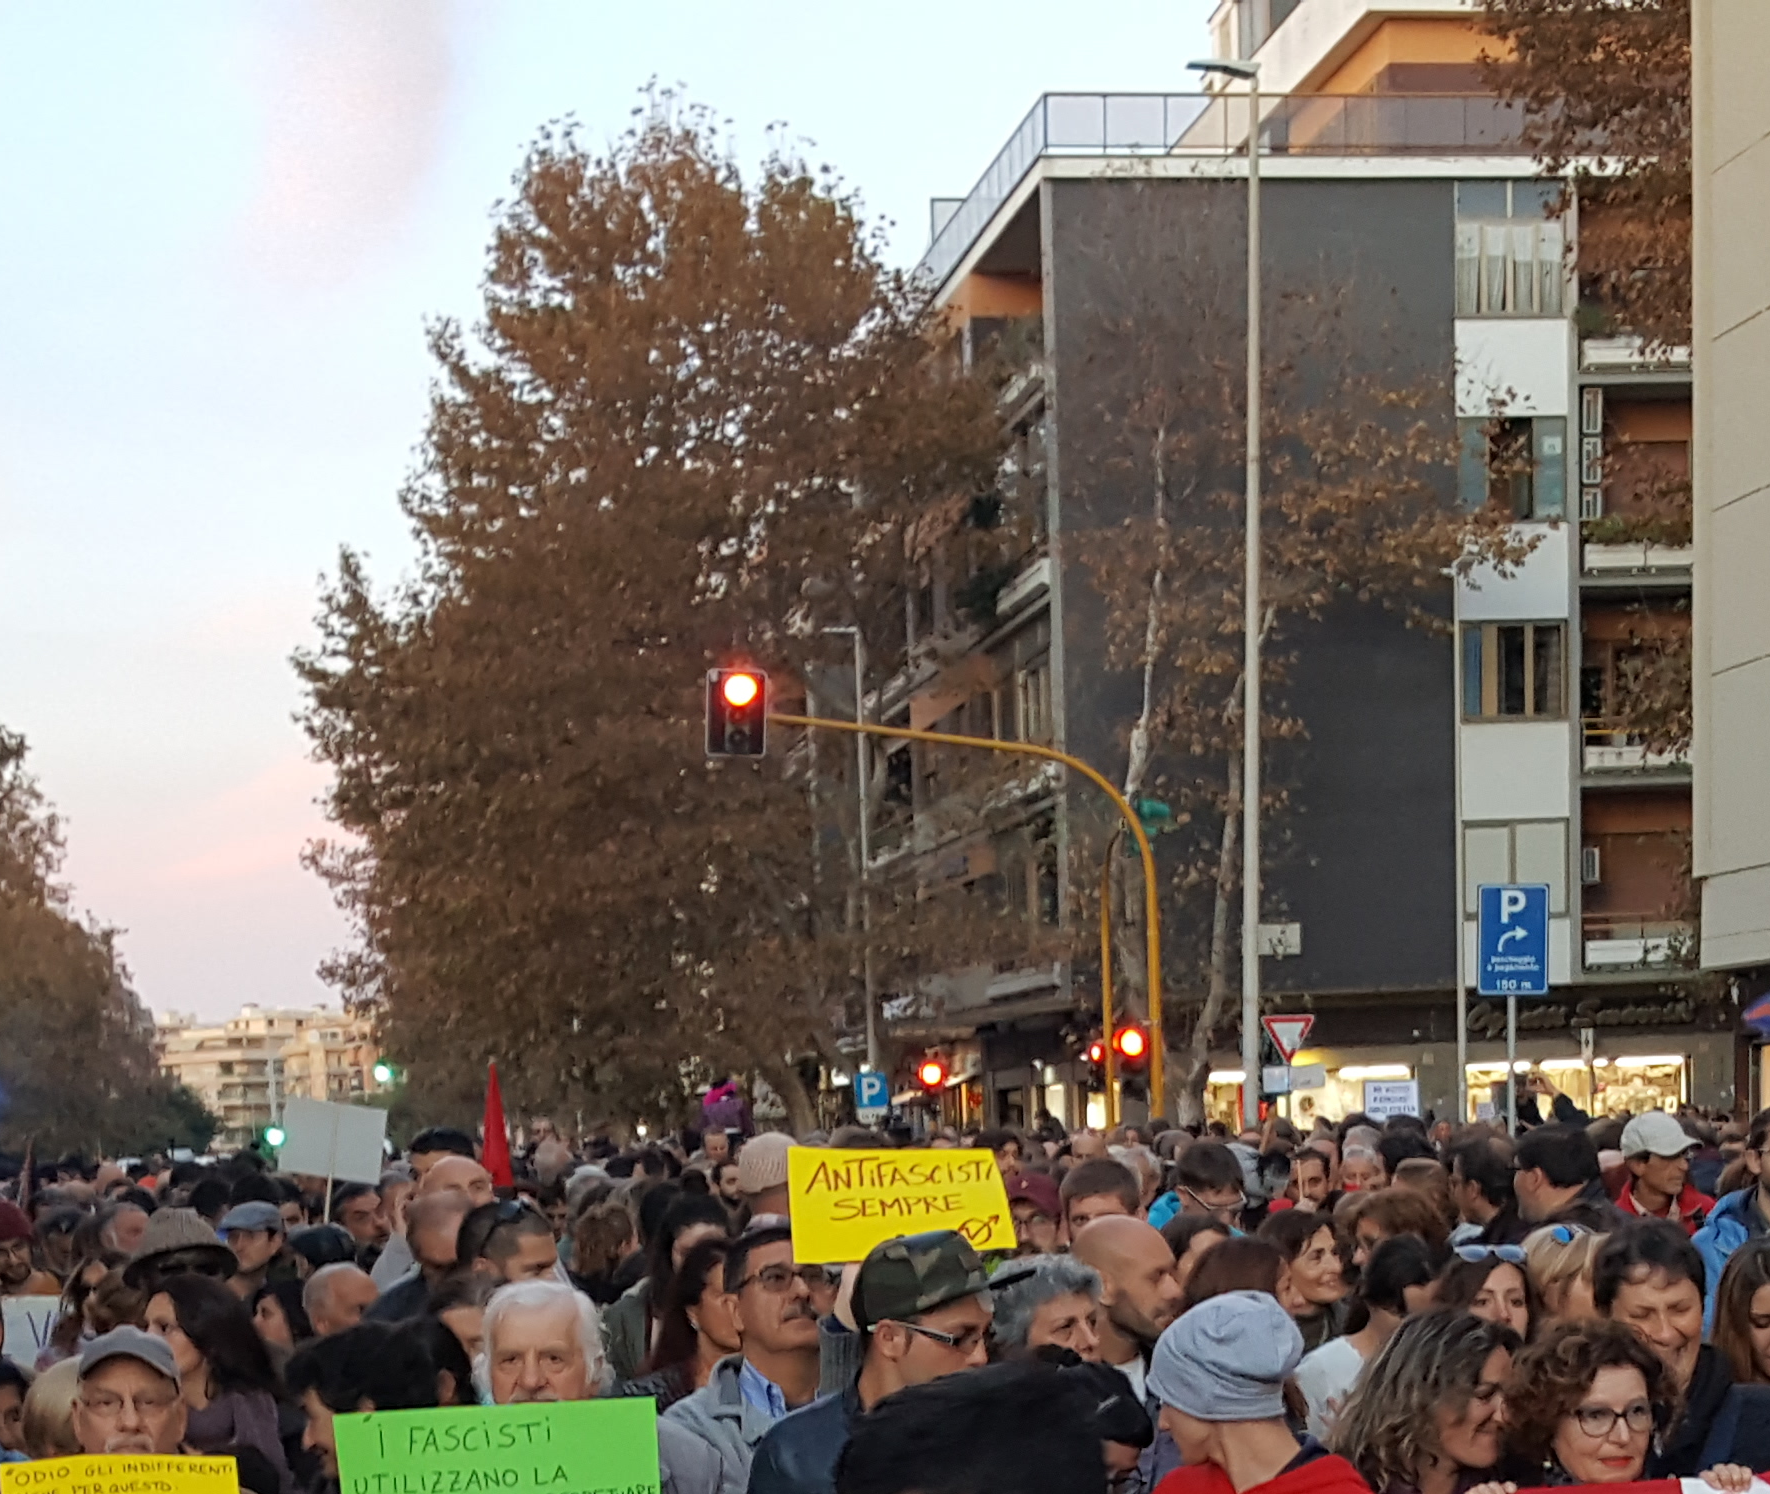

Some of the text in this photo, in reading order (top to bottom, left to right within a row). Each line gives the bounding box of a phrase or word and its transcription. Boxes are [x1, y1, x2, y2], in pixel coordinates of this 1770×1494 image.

[1500, 889, 1527, 924] P
[861, 1077, 881, 1105] P
[829, 1193, 966, 1221] SEMPRE
[85, 1463, 114, 1478] GLI
[533, 1465, 569, 1486] LA
